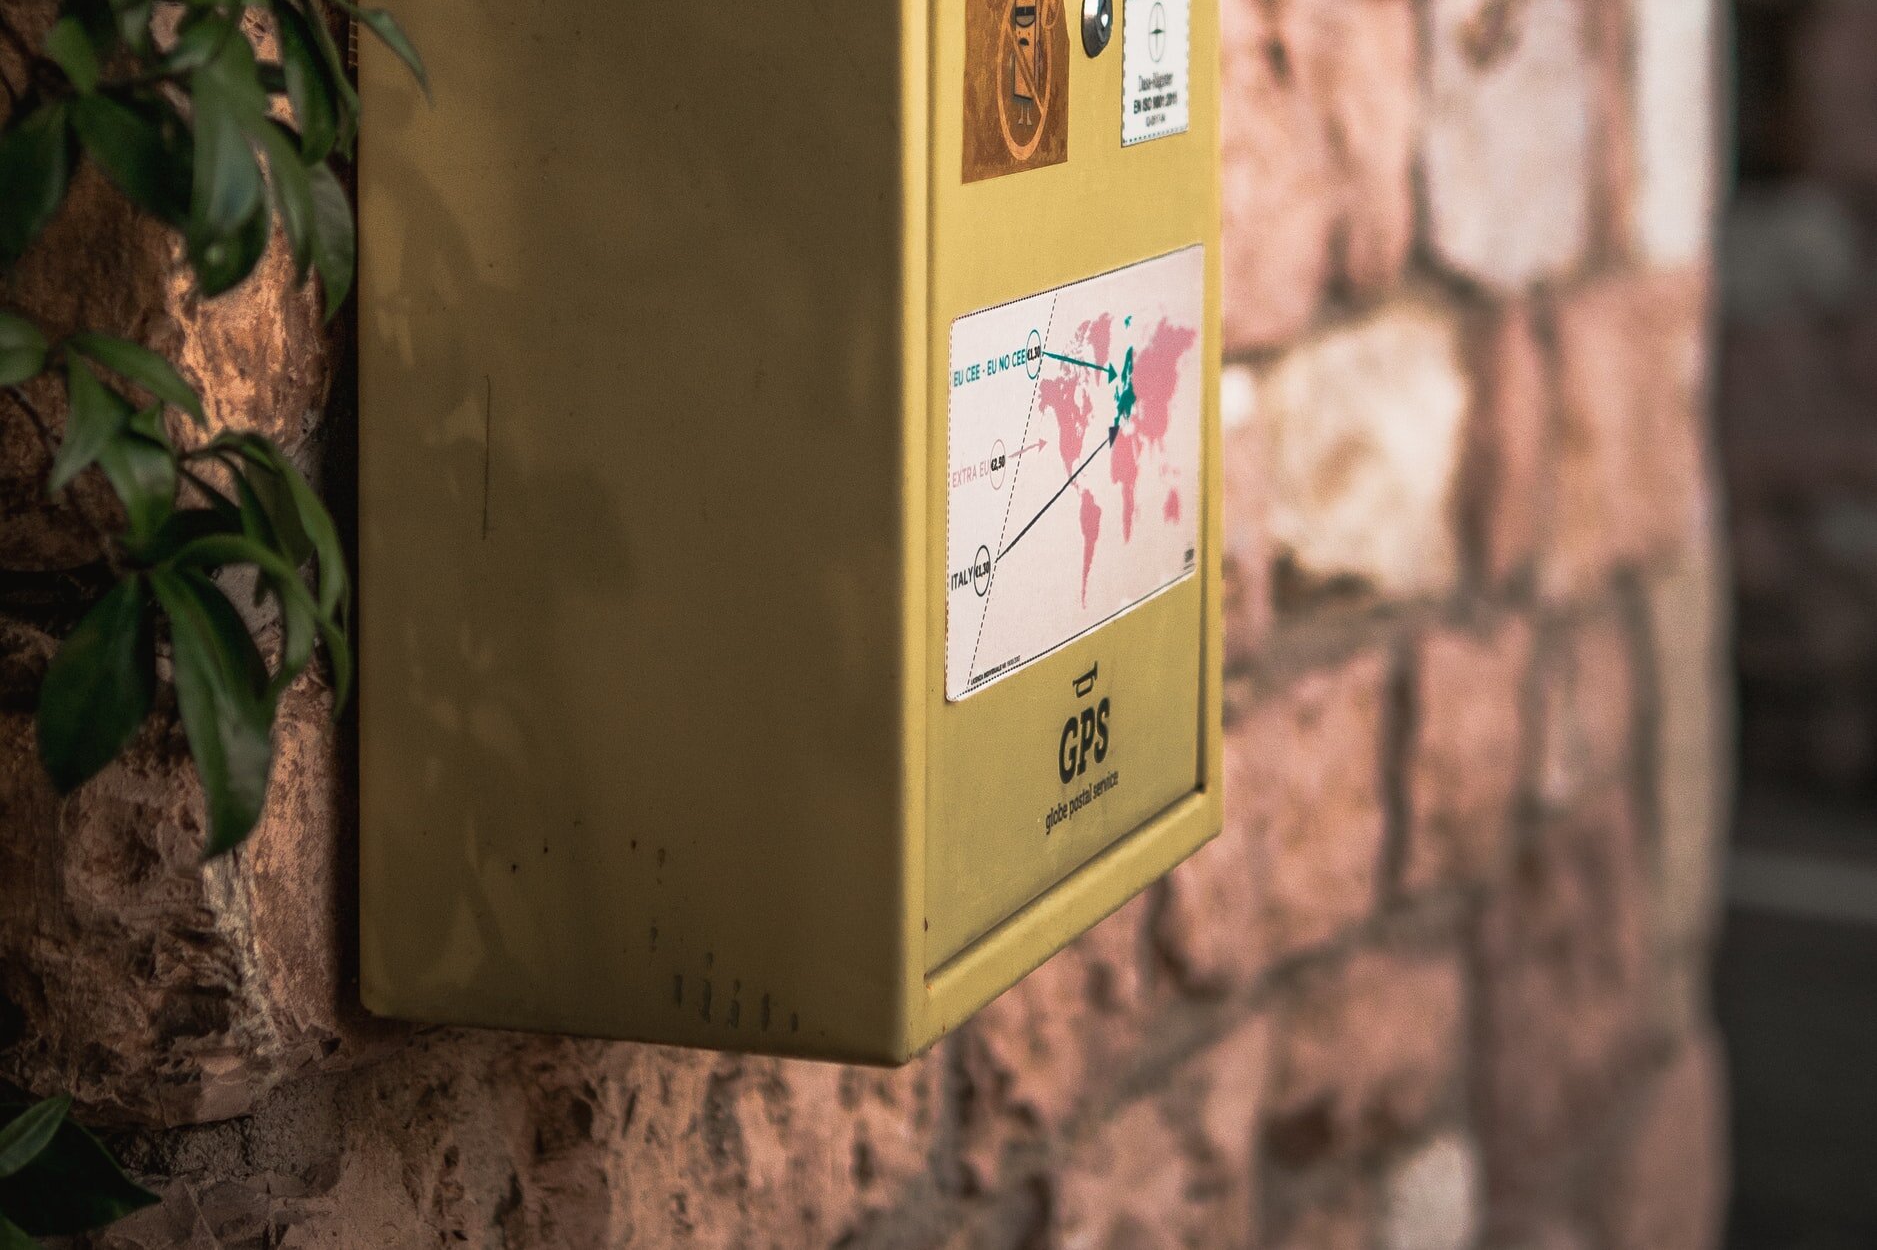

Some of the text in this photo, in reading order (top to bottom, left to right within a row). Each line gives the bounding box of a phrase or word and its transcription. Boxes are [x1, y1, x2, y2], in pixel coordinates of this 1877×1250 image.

[953, 371, 964, 387] EU
[965, 364, 980, 383] CEE
[987, 358, 998, 376] EU
[999, 354, 1010, 371] NO
[1011, 349, 1026, 367] CEE
[952, 465, 977, 488] EXTRA
[979, 459, 990, 478] EU
[951, 566, 974, 591] ITALY
[1058, 696, 1111, 785] GPS
[1045, 770, 1119, 836] globe postal service
